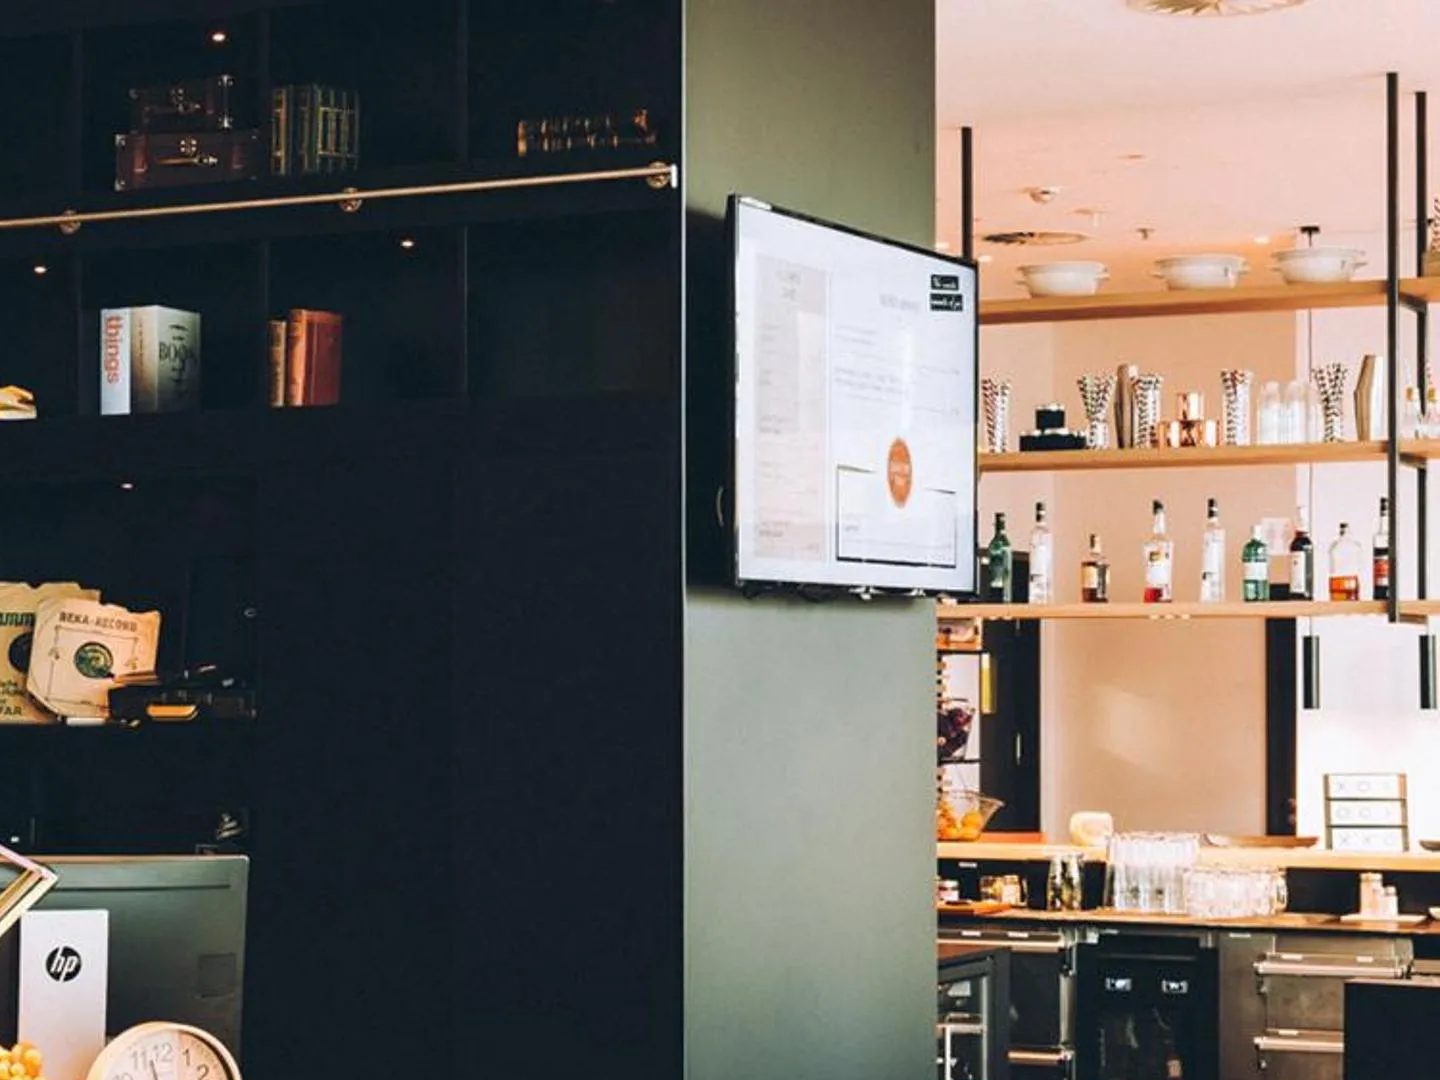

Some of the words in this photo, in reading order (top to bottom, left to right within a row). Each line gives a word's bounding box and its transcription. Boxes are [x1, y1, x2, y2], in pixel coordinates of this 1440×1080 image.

[104, 315, 122, 385] things
[47, 946, 81, 982] hp
[131, 1051, 148, 1071] 11
[152, 1042, 173, 1063] 12
[182, 1049, 191, 1067] 1
